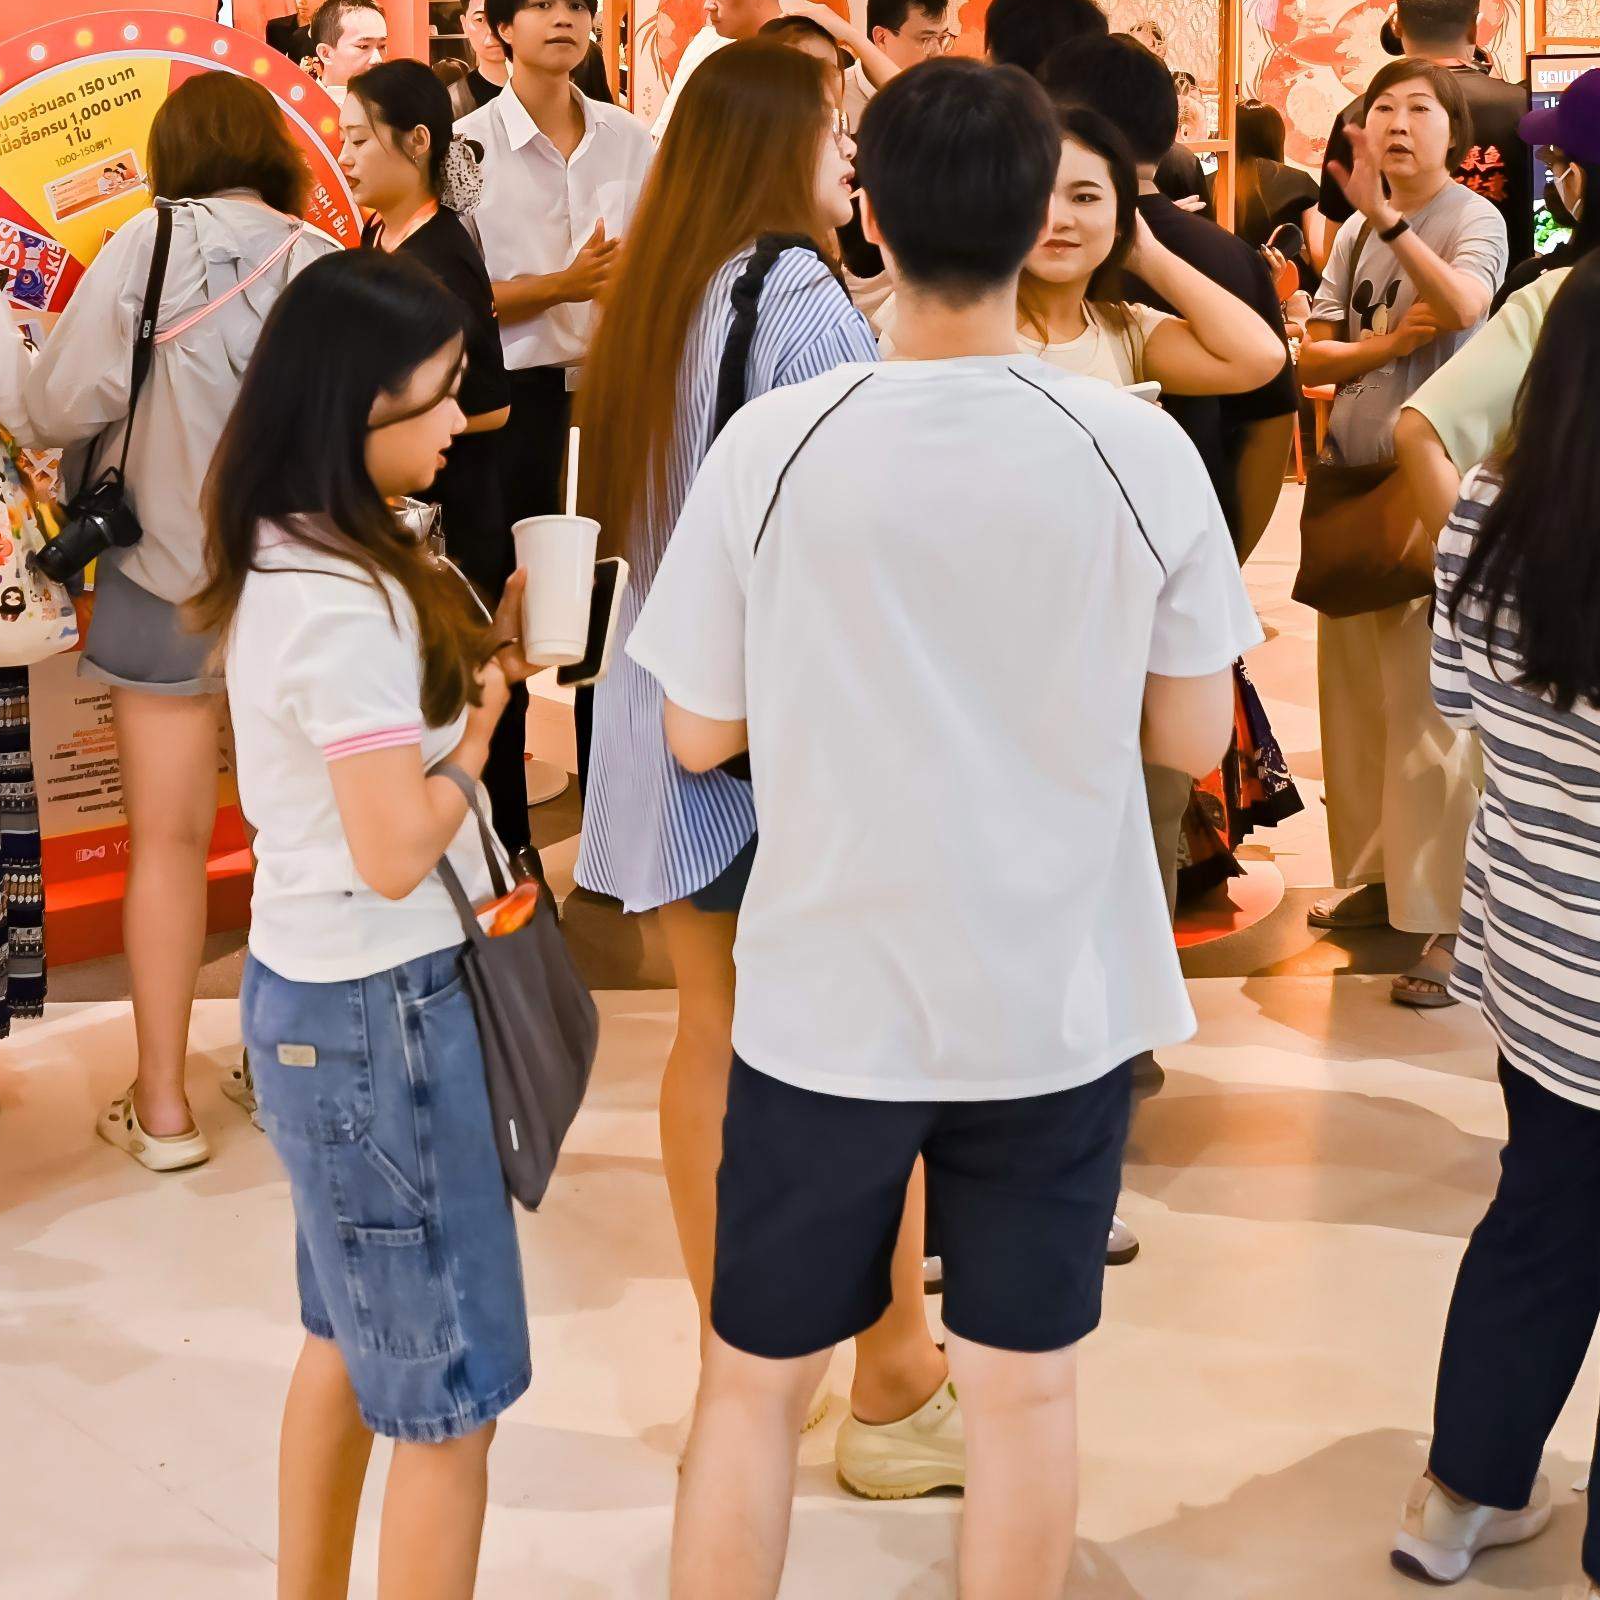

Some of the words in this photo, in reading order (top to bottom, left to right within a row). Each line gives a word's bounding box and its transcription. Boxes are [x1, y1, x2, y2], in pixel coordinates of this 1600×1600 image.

[78, 77, 105, 98] 150
[107, 67, 135, 86] บาท
[69, 99, 111, 128] 1,000
[114, 88, 142, 107] บาท
